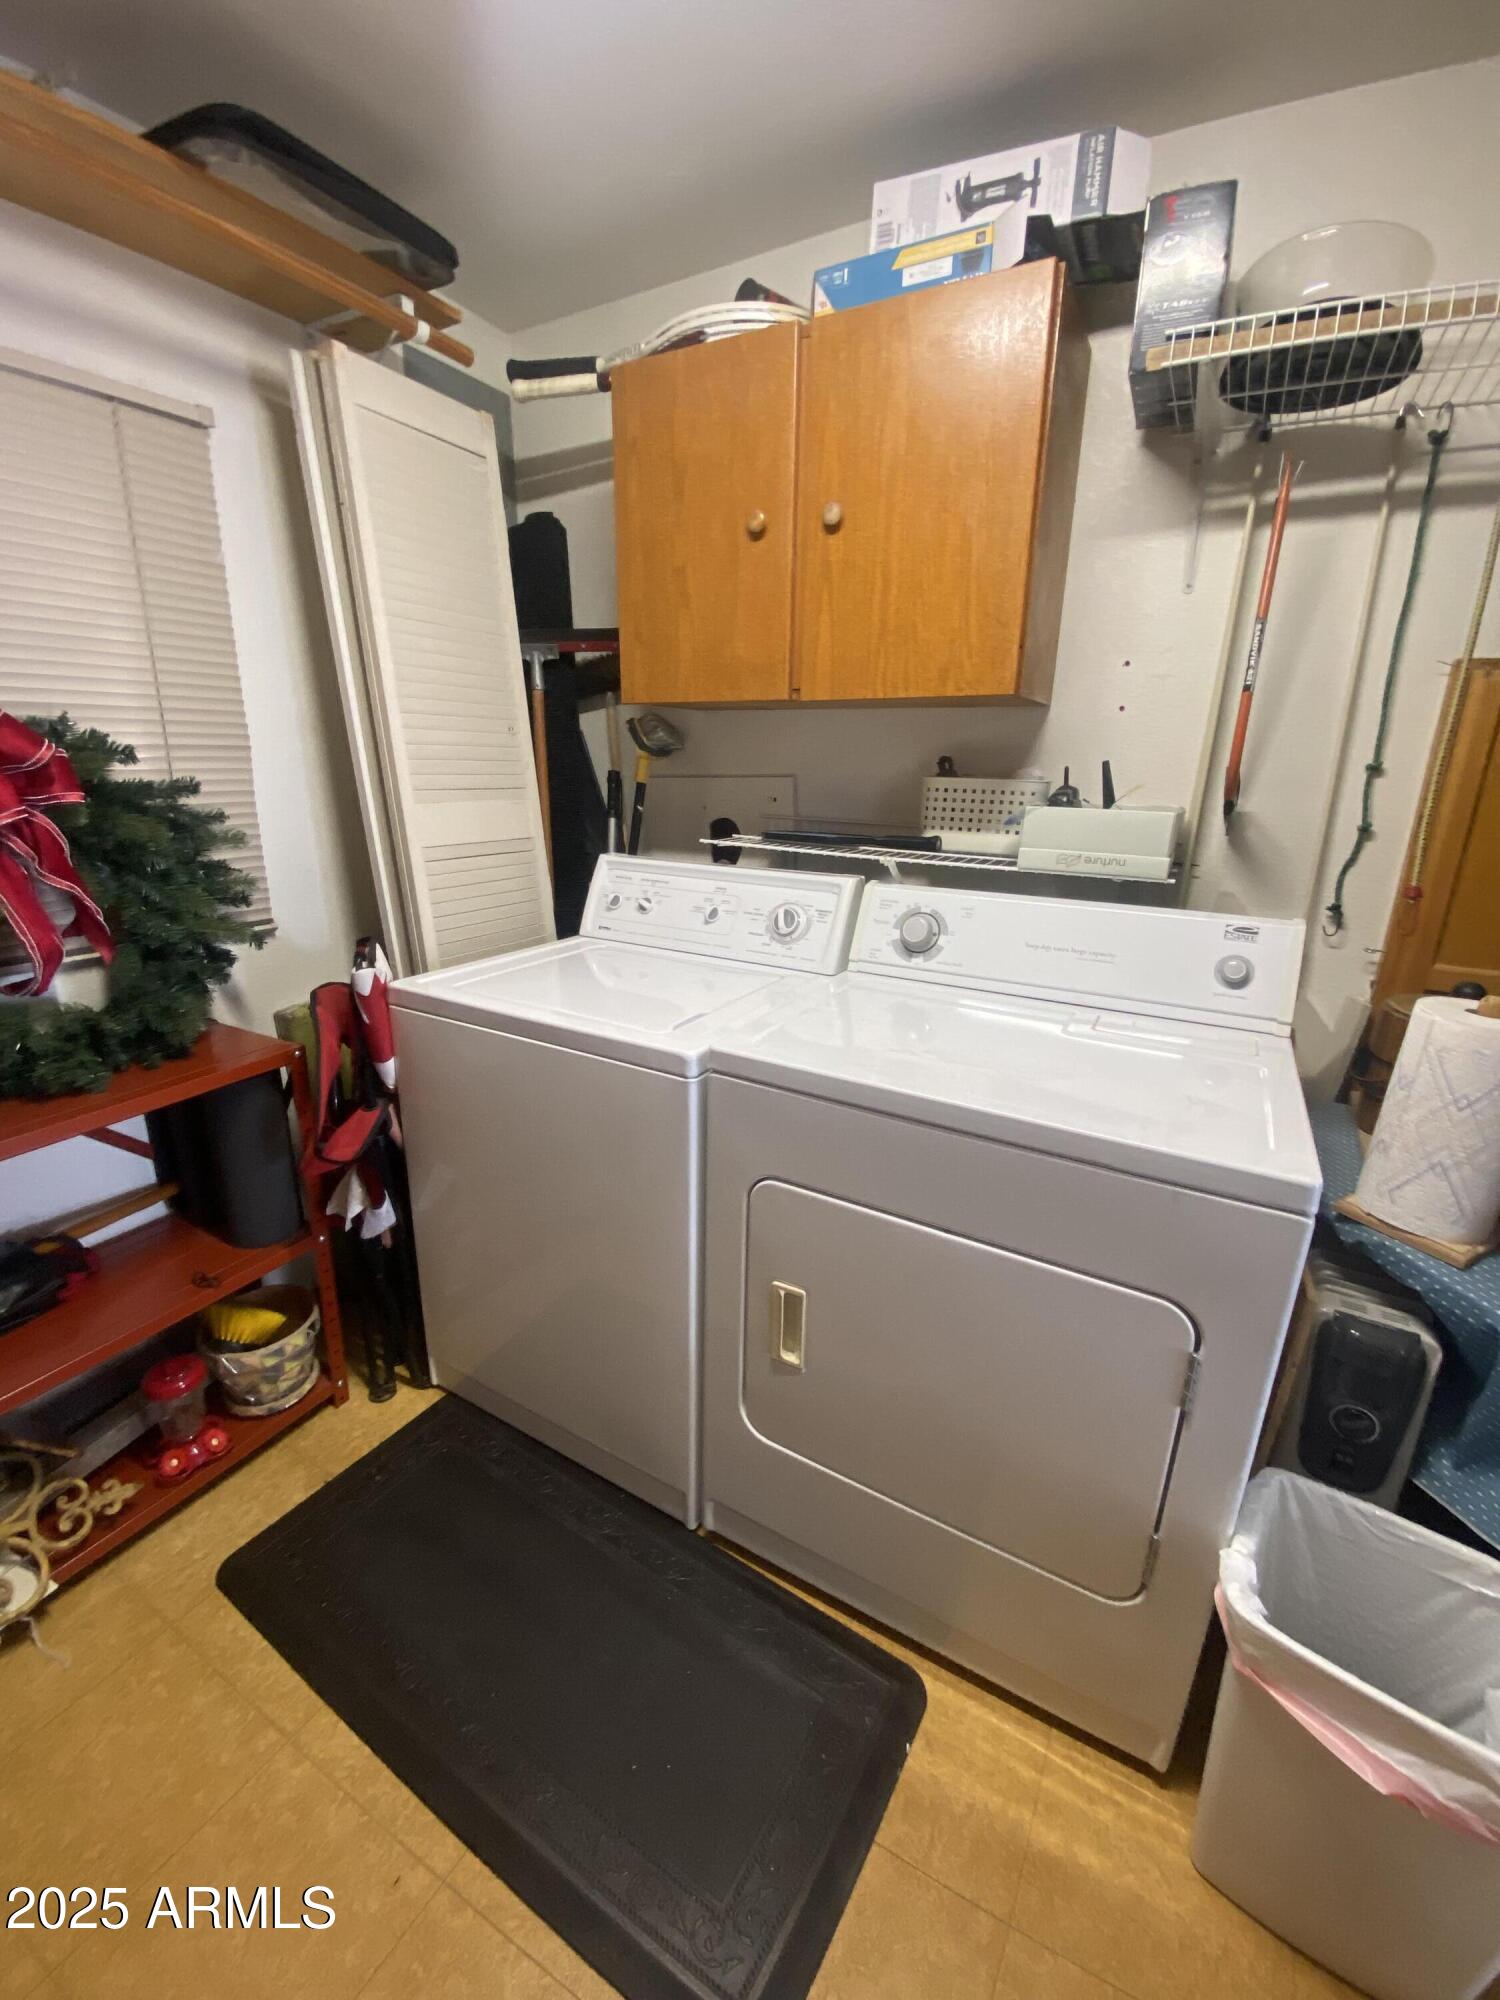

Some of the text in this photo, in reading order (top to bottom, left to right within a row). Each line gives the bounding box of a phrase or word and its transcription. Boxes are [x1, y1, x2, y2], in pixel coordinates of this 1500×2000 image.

[1090, 134, 1106, 207] AIR HAMMER
[1249, 623, 1262, 666] SANDVIK
[1083, 855, 1127, 867] nurture
